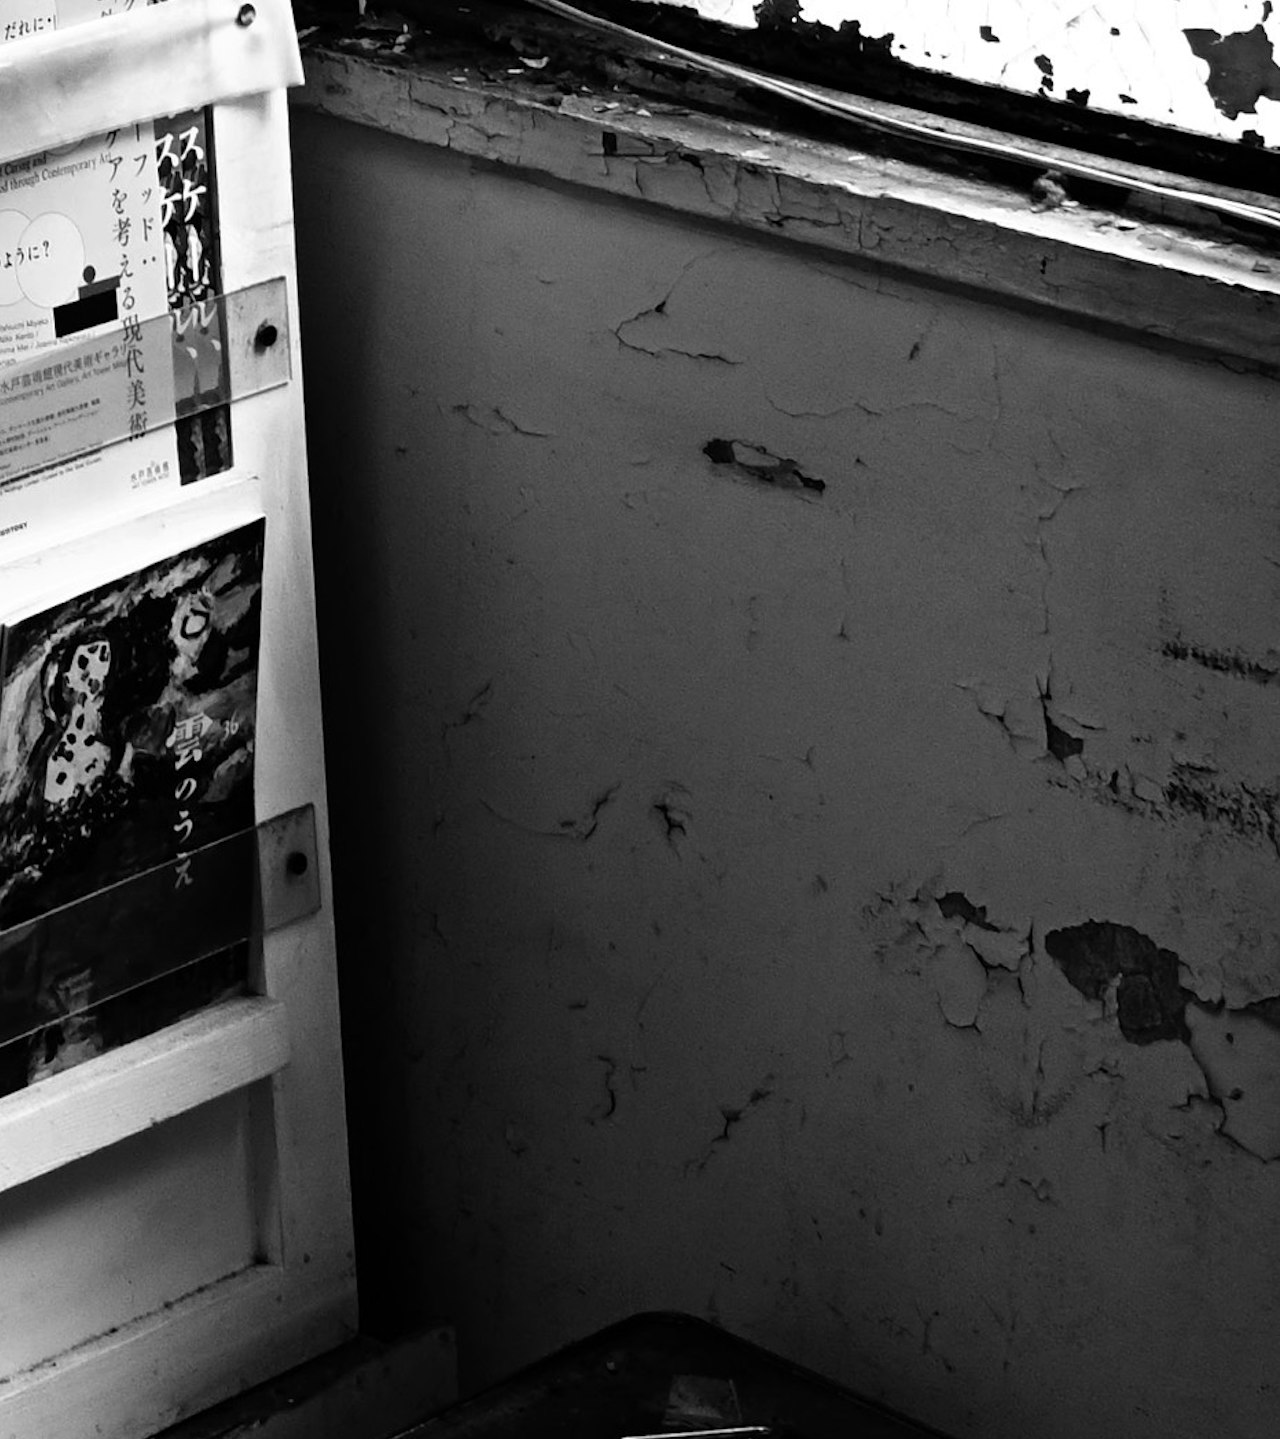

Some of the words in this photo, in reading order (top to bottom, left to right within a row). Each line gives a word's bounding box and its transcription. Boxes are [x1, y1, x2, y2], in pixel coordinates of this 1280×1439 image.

[9, 170, 41, 191] through
[41, 159, 96, 182] Contemporary
[165, 711, 213, 890] 雲のうえ
